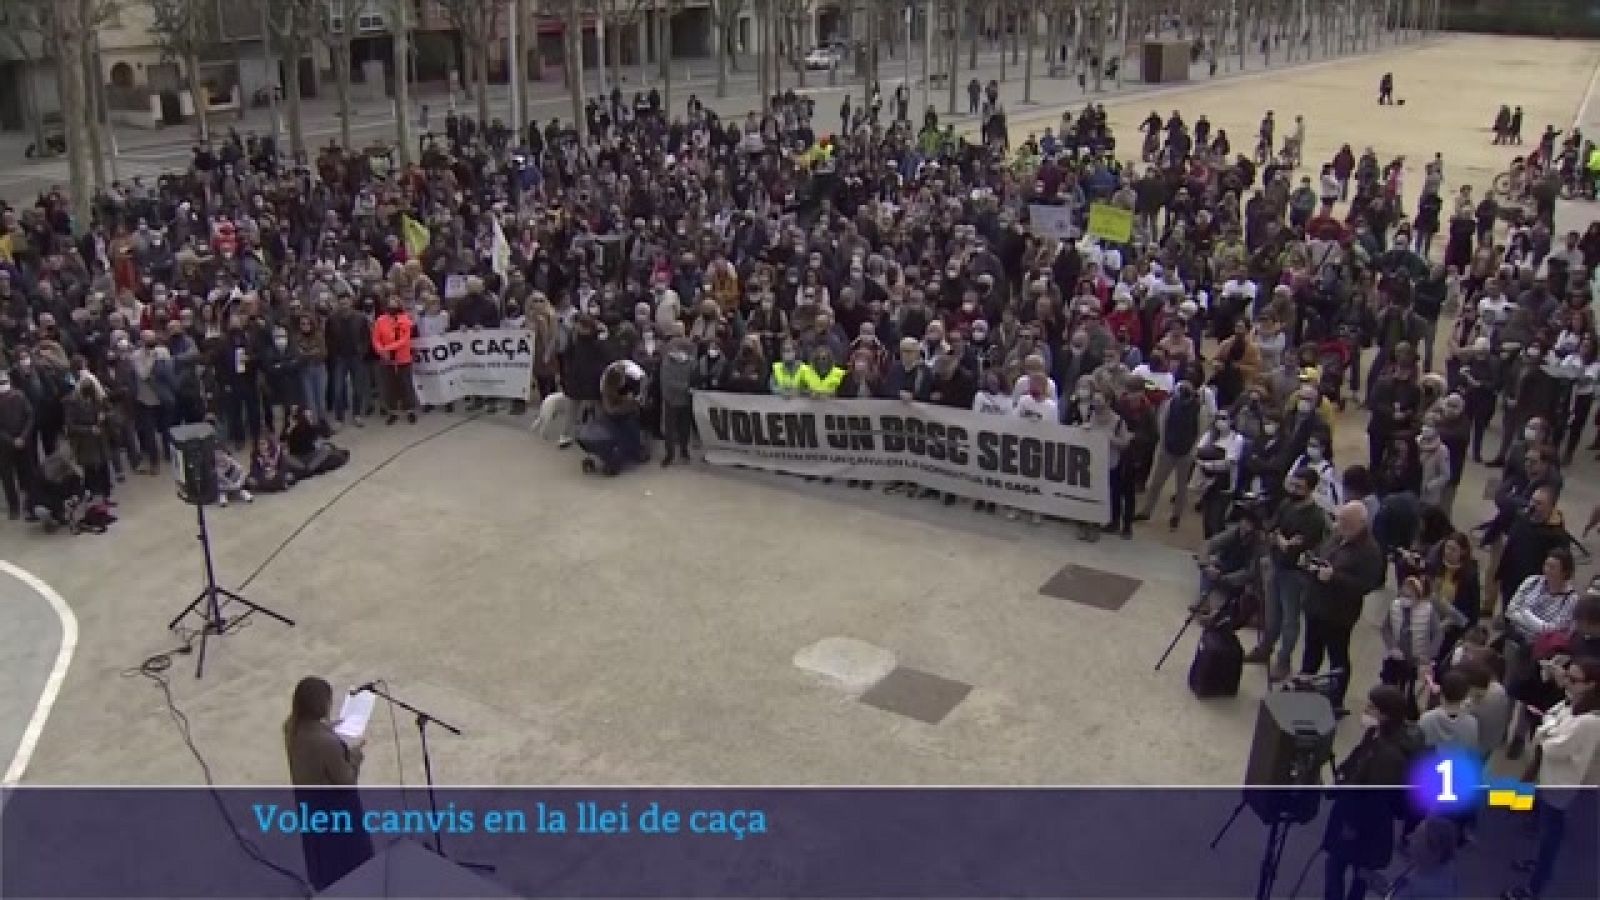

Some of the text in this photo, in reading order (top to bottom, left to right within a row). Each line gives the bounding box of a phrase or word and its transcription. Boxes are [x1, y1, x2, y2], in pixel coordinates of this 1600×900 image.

[471, 338, 530, 360] CAÇA
[708, 407, 1092, 488] VOLEM UN BOSC SEGUR
